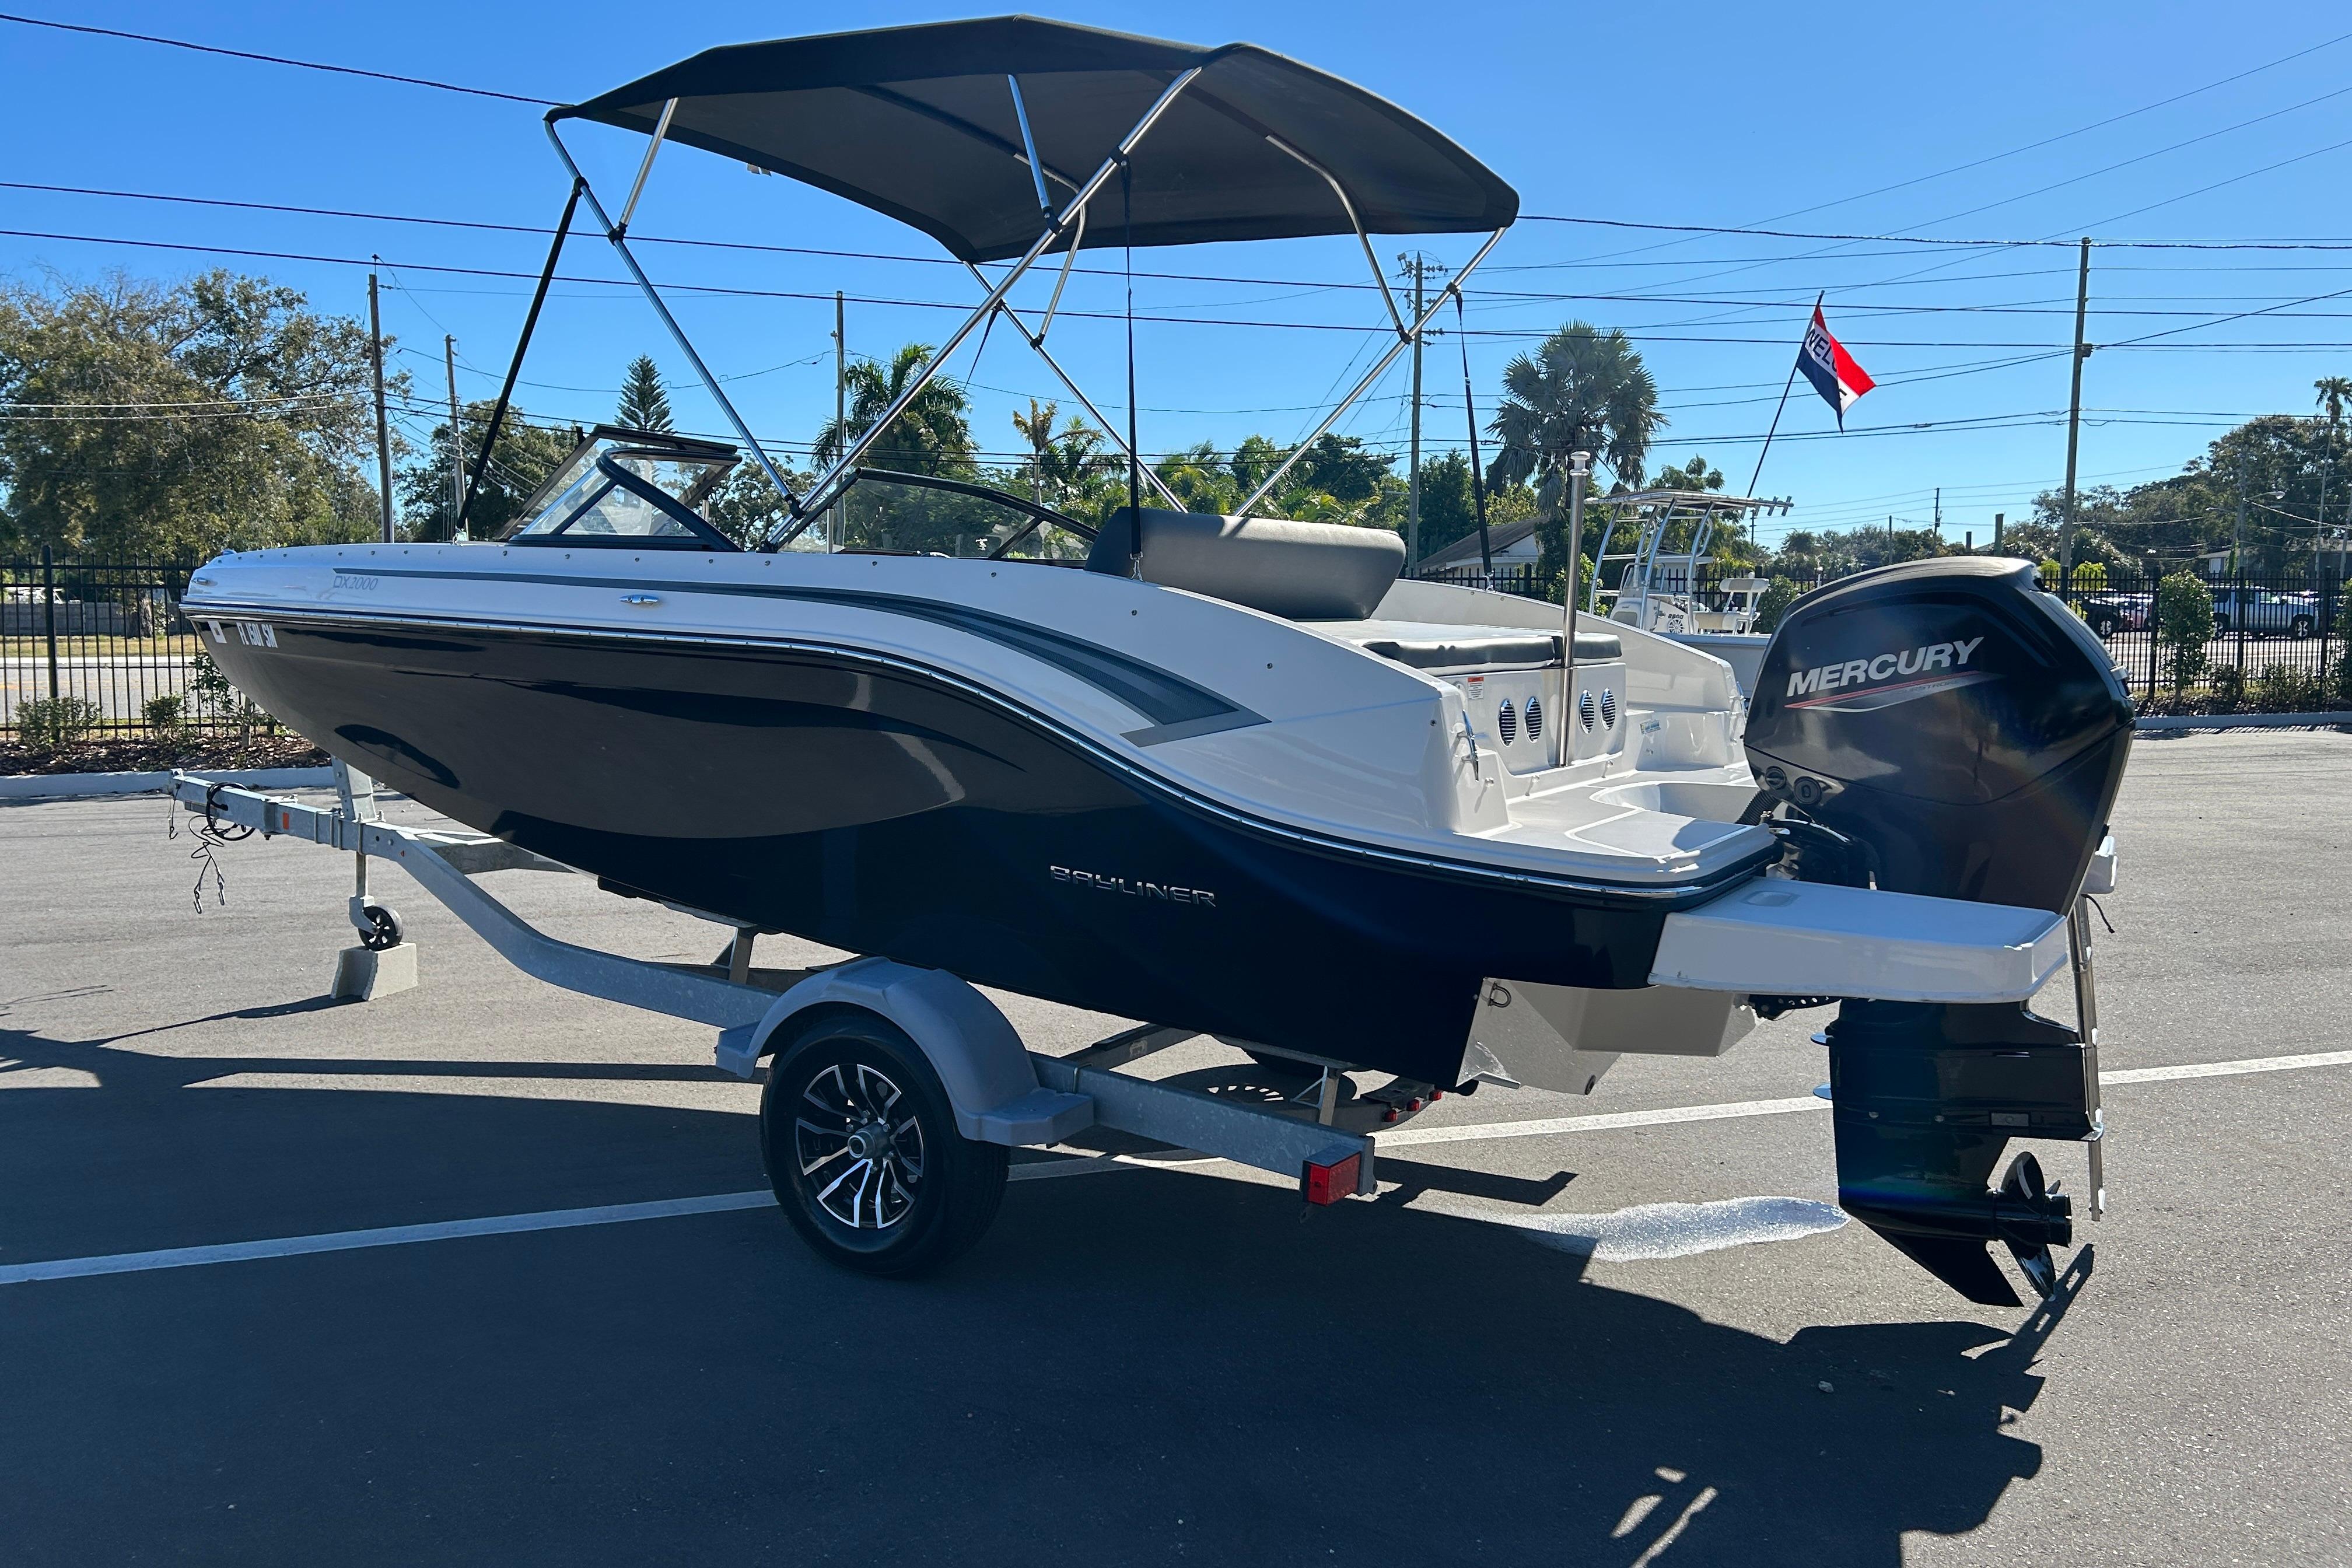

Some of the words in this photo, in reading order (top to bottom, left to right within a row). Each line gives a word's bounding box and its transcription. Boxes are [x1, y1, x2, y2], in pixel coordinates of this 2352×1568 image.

[333, 575, 379, 591] DX2000
[236, 622, 250, 645] FL
[261, 624, 278, 648] SM
[1786, 636, 1985, 697] MERCURY
[1050, 865, 1216, 908] BAYLINER
